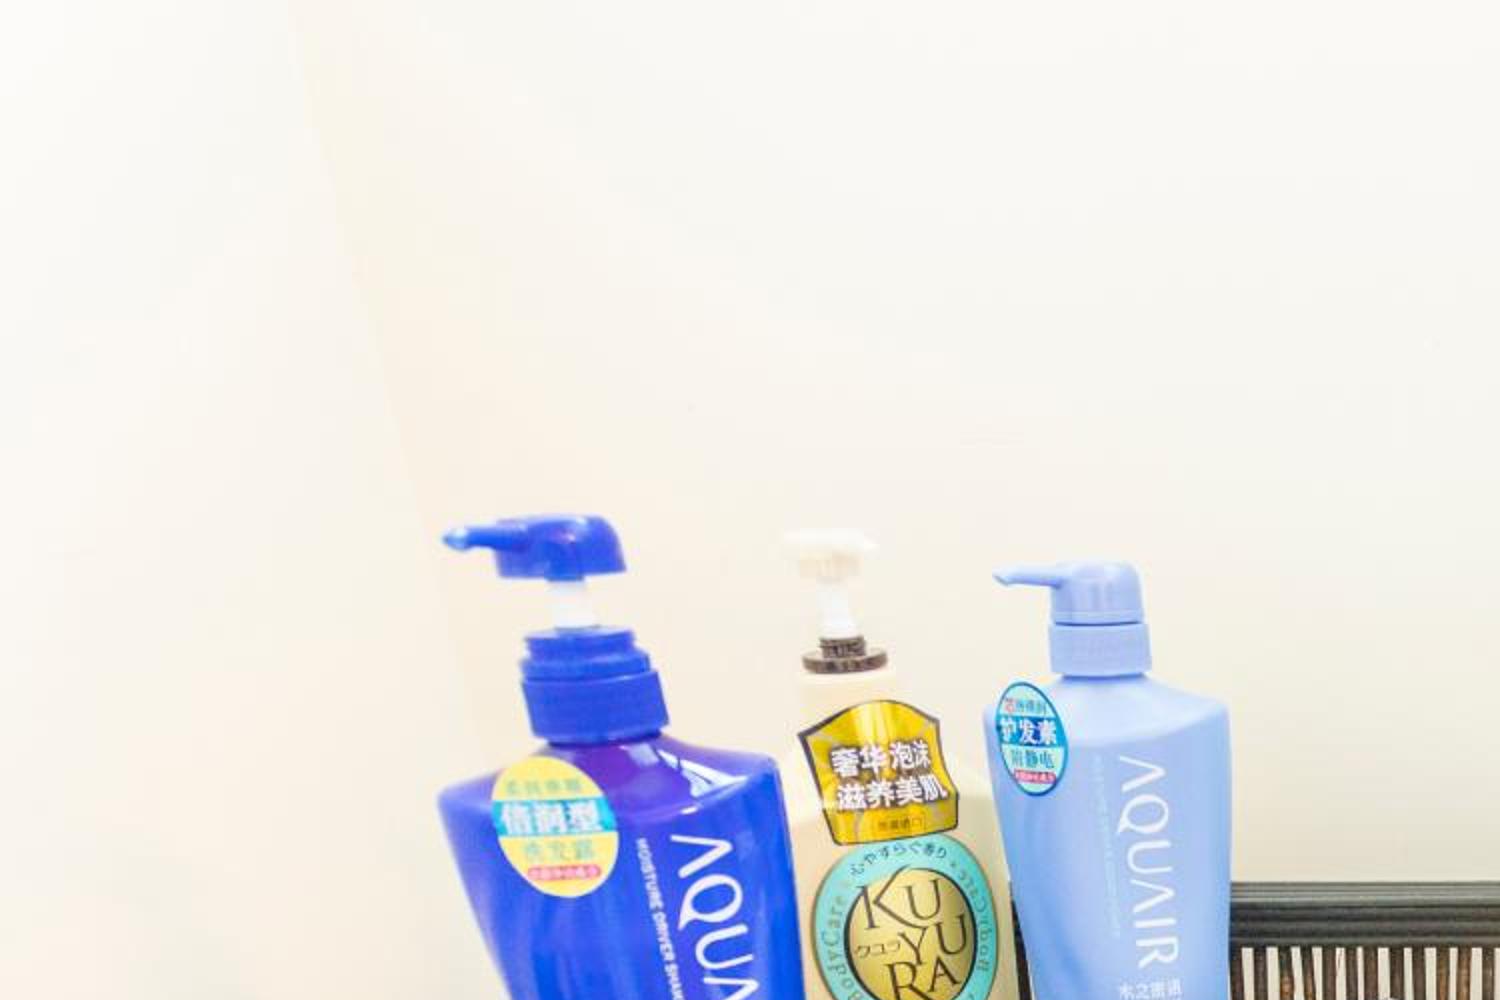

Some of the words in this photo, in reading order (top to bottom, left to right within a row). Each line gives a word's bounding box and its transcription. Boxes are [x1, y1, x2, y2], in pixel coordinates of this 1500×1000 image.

[837, 773, 948, 810] 滋养美肌
[1117, 755, 1180, 969] AQUAIR
